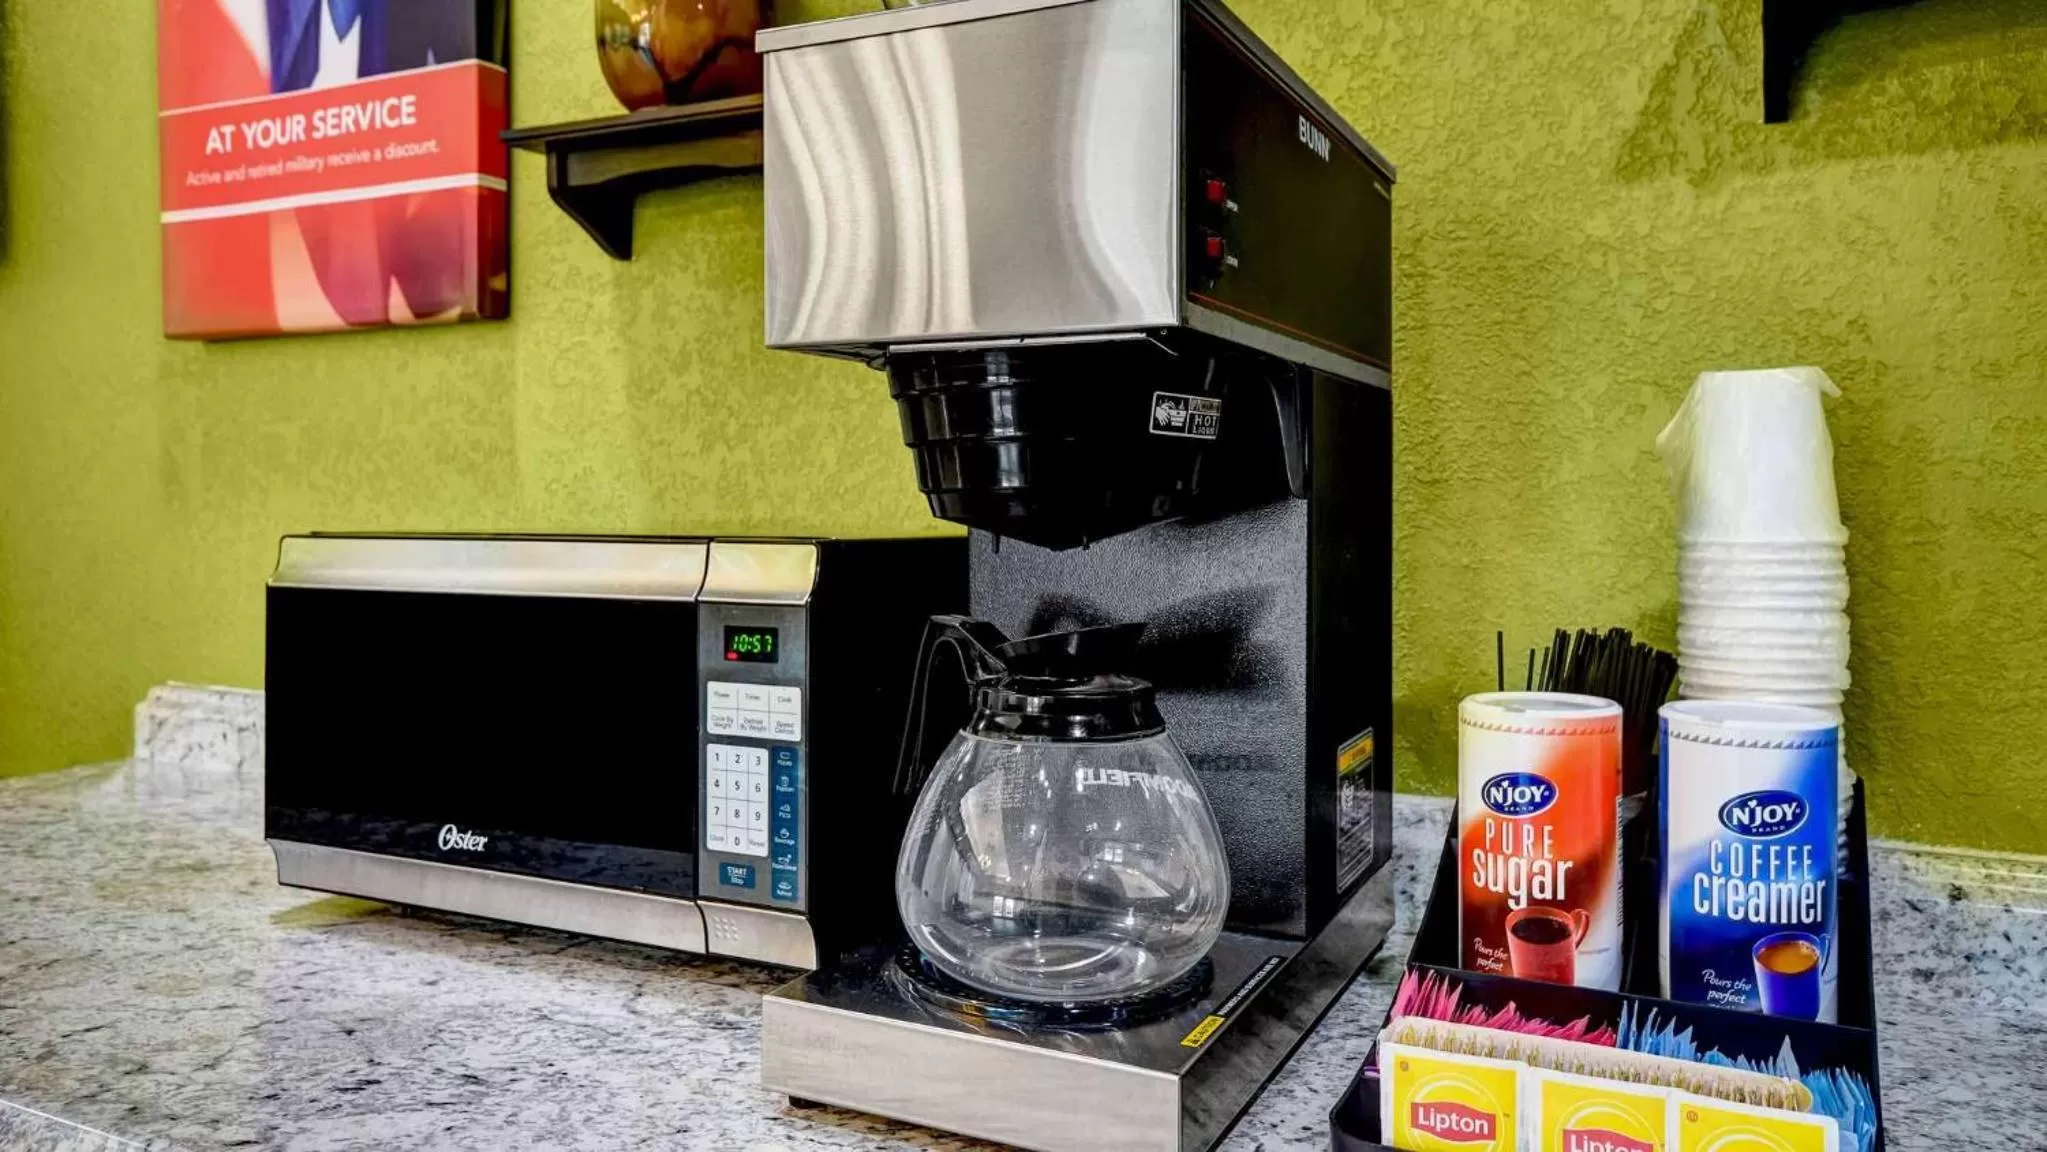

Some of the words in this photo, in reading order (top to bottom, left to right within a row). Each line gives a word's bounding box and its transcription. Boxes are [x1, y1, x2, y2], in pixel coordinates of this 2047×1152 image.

[205, 125, 236, 155] AT
[241, 114, 306, 149] YOUR
[312, 95, 417, 140] SERVICE
[1299, 115, 1330, 162] BUNN
[186, 170, 221, 186] Active
[224, 165, 245, 183] and
[248, 161, 284, 179] retired
[285, 155, 325, 174] military
[327, 149, 371, 167] receive
[373, 148, 382, 161] a
[384, 139, 441, 161] discount.
[733, 634, 773, 653] 10:57
[714, 752, 720, 762] 1
[734, 754, 741, 764] 2
[755, 755, 761, 766] 3
[713, 779, 720, 788] 4
[734, 780, 741, 791] 5
[755, 782, 761, 793] 6
[713, 806, 720, 816] 7
[734, 808, 741, 819] 8
[755, 811, 761, 821] 9
[438, 824, 488, 852] Oster
[734, 836, 741, 847] 0
[1485, 818, 1554, 860] PURE
[1710, 839, 1813, 881] COFFEE
[1472, 848, 1573, 911] sugar
[1693, 871, 1826, 925] creamer
[1702, 968, 1732, 988] Pours
[1734, 978, 1752, 991] the
[1706, 988, 1746, 1004] perfect
[1418, 1106, 1489, 1135] Lipton
